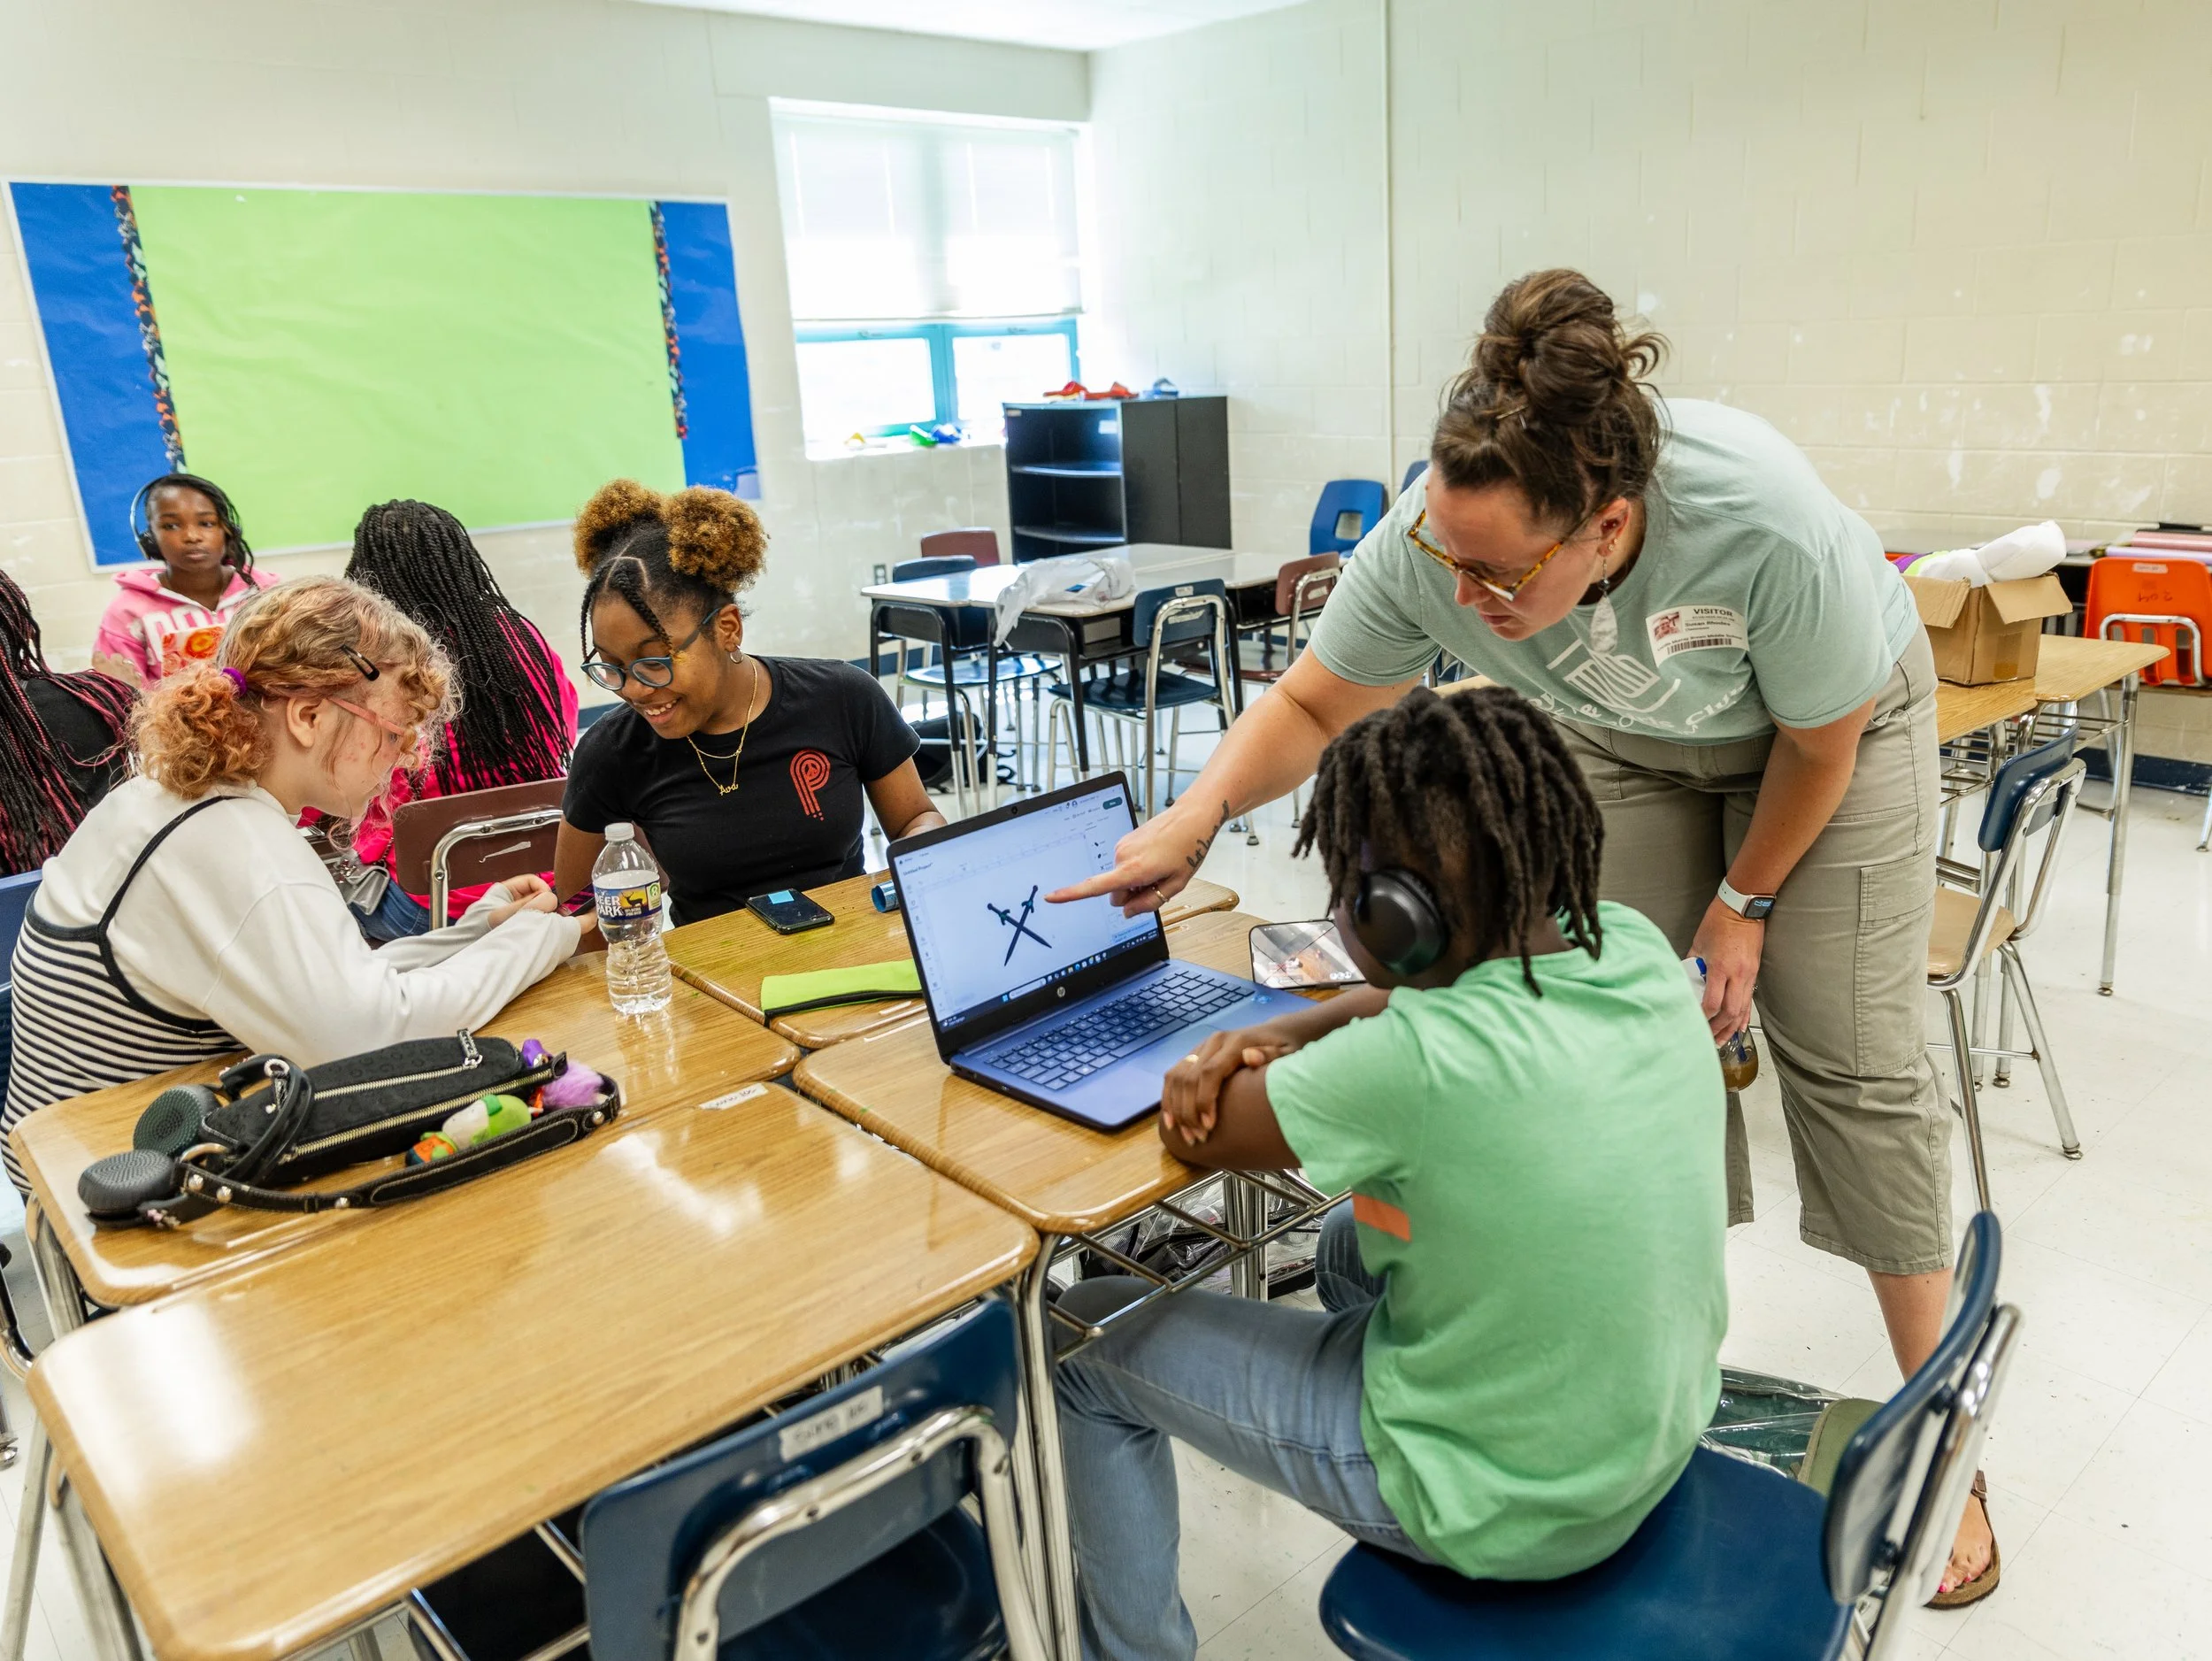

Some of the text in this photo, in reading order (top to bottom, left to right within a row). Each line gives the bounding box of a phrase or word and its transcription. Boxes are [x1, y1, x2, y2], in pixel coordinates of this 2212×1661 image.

[1694, 608, 1733, 618] VISITOR
[719, 783, 739, 796] Ava
[595, 905, 623, 917] PARK
